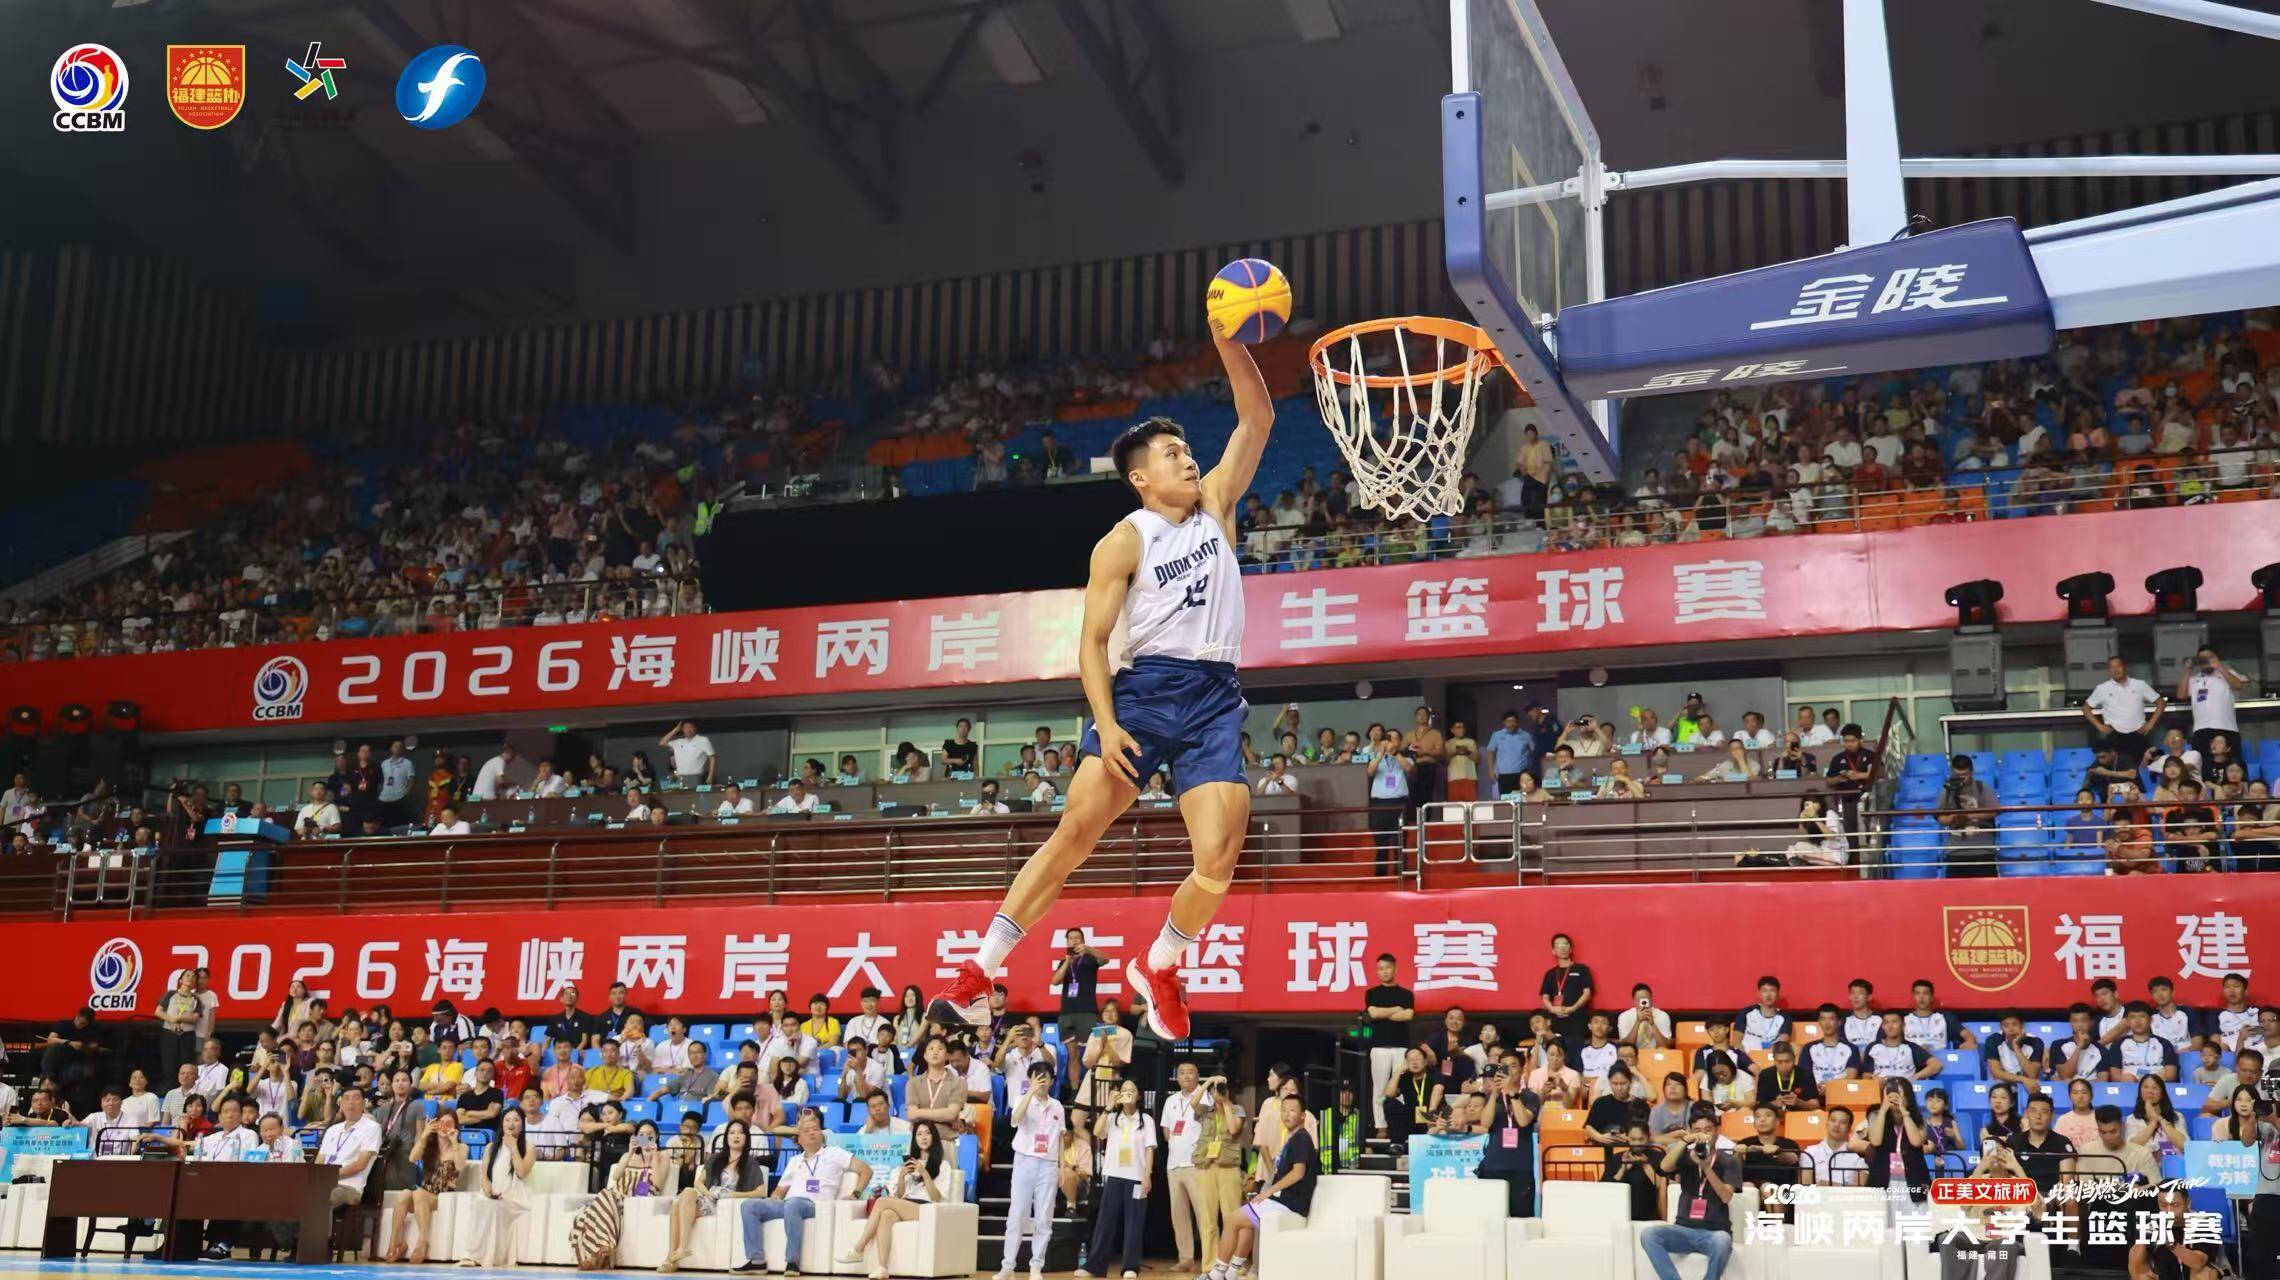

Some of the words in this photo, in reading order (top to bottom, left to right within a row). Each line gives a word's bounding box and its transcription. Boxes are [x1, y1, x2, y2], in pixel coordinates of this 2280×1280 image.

[1751, 263, 2008, 330] 金陵
[1607, 360, 1848, 394] 金陵
[255, 704, 302, 719] CCBM
[2055, 912, 2253, 980] 福建
[90, 995, 134, 1009] CCBM
